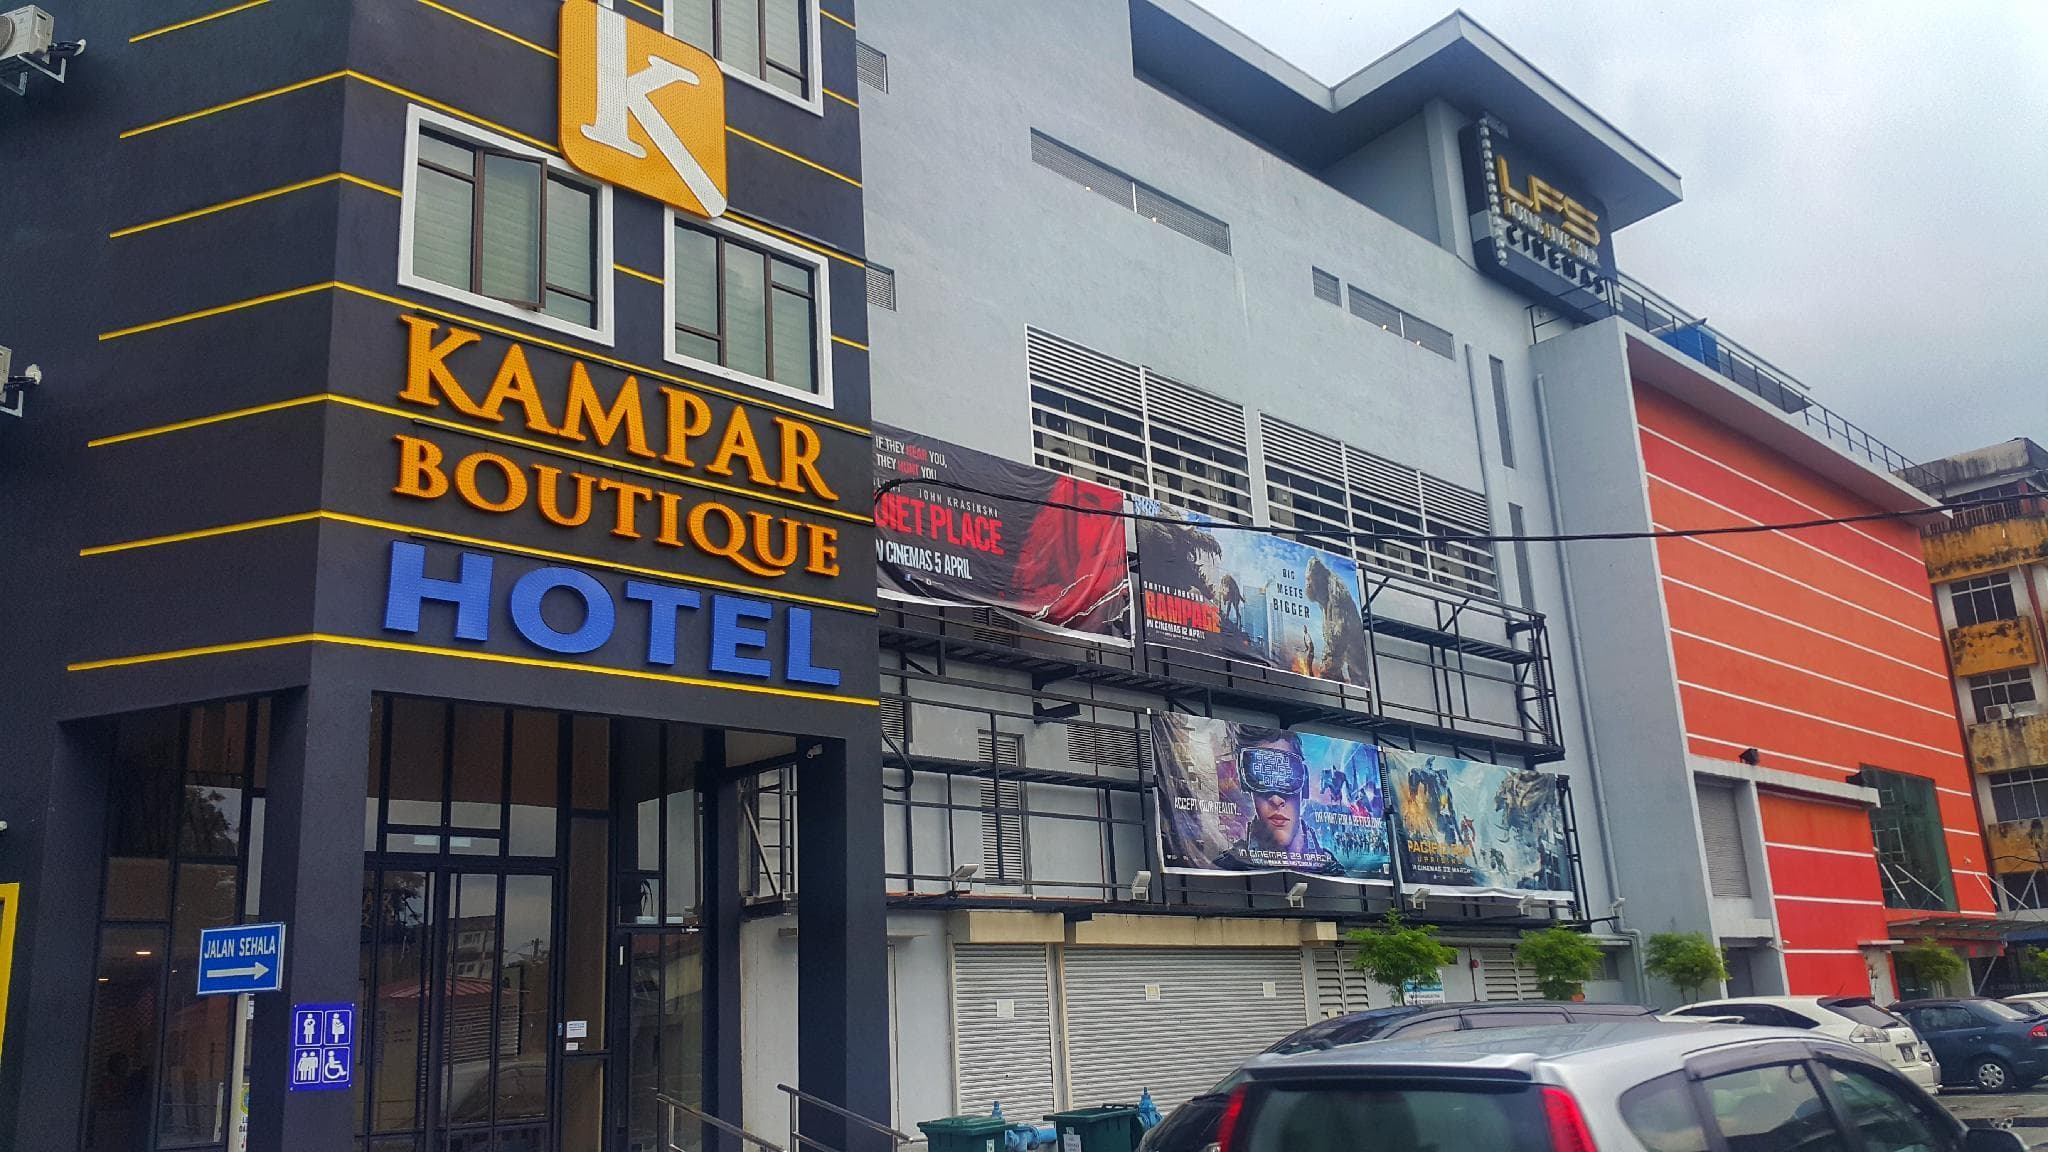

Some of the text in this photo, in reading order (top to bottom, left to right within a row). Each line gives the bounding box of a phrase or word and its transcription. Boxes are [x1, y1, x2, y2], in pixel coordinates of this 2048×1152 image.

[581, 3, 728, 218] K
[1497, 153, 1600, 247] LFS
[1506, 224, 1604, 294] CINEMAS
[399, 313, 839, 501] KAMPAR
[875, 435, 884, 449] IF
[884, 437, 905, 455] THEY
[928, 450, 948, 469] YOU,
[875, 453, 896, 470] THEY
[392, 433, 840, 578] BOUTIQUE
[918, 488, 998, 518] JOHN KRASINSKI
[873, 492, 1005, 556] UIET PLACE
[886, 541, 933, 572] CINEMAS
[934, 552, 942, 574] 5
[944, 554, 973, 580] APRIL
[1282, 568, 1296, 580] BIG
[1272, 597, 1310, 619] BIGGER
[1276, 583, 1303, 599] MEETS
[383, 539, 841, 687] HOTEL
[1144, 589, 1221, 633] RAMPAGE
[1154, 620, 1181, 634] CINEMAS
[1174, 796, 1198, 811] ACCEPT
[1249, 849, 1287, 860] CINEMAS
[1290, 852, 1302, 860] 29
[1303, 853, 1332, 862] MARCH
[204, 935, 276, 959] JALAN SEHALA
